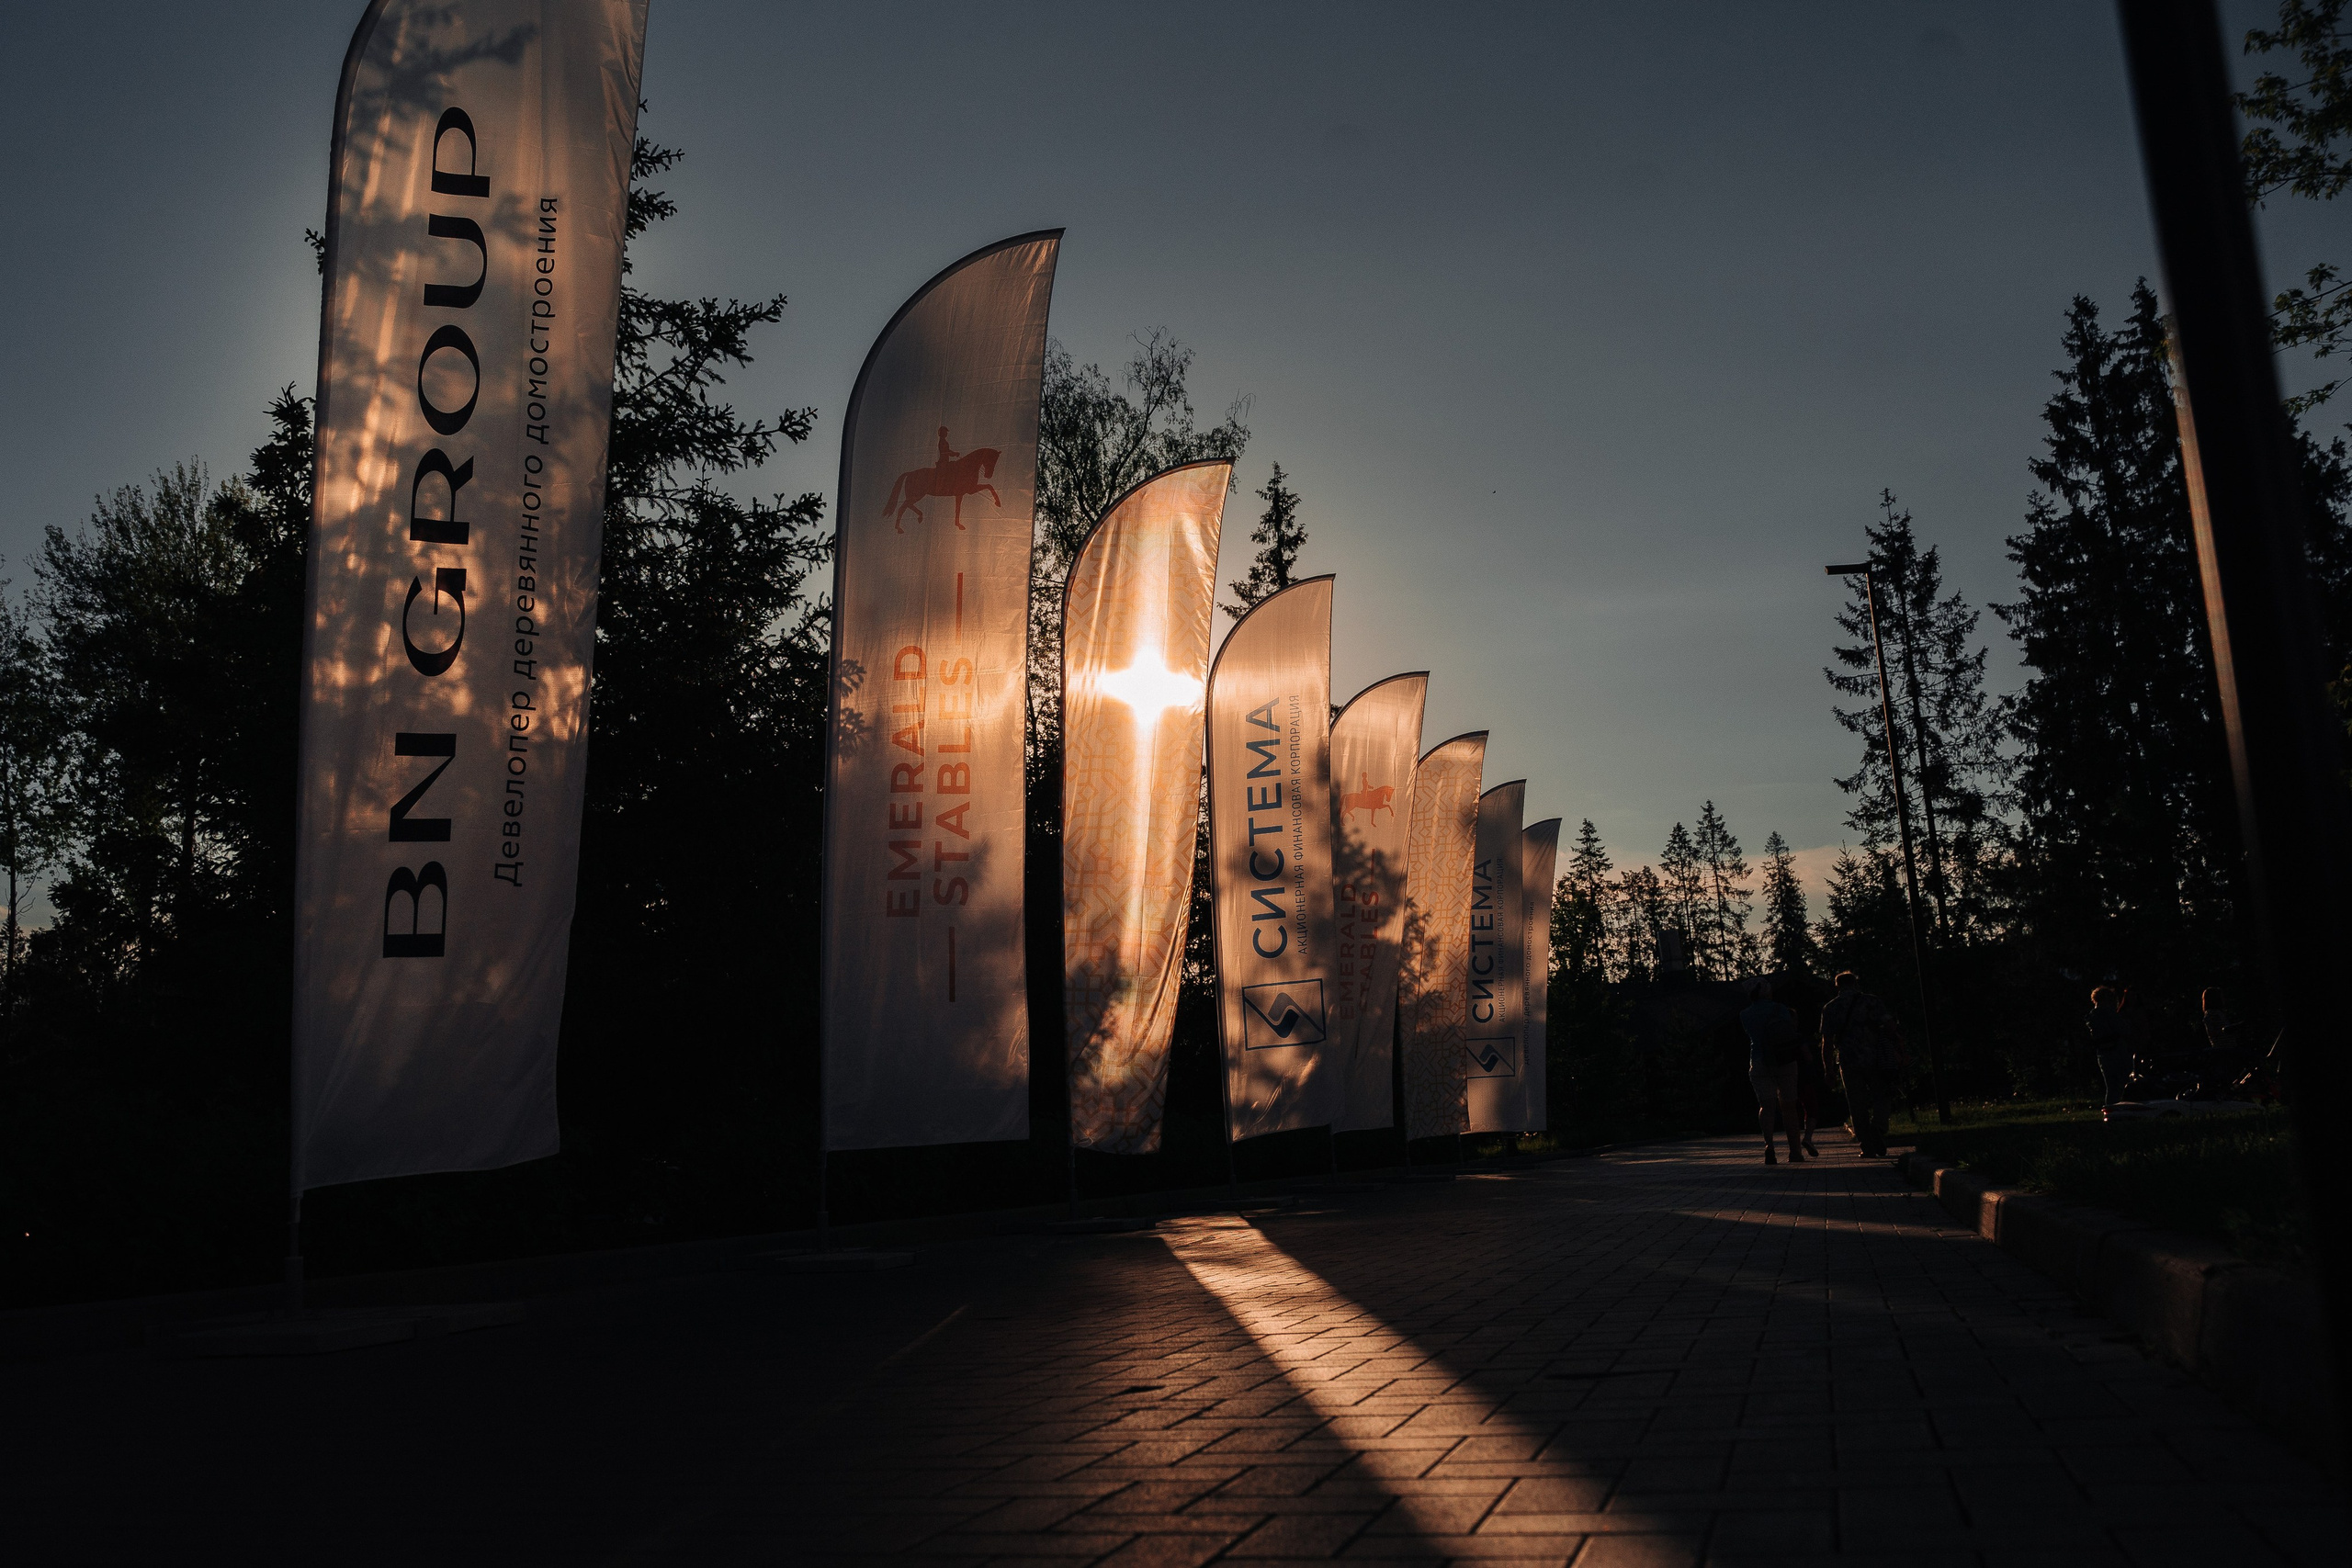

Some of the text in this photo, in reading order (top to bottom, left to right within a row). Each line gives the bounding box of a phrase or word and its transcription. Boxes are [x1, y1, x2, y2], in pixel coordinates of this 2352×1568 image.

[382, 107, 492, 959] BN GROUP
[494, 197, 560, 887] Девелопер деревянного домостроения
[887, 645, 927, 919] EMERALD
[933, 656, 973, 907] STABLES
[1245, 696, 1288, 959] СИСТЕМА
[1288, 694, 1308, 954] АКЦИОНЕРНАЯ ФИНАНСОВАЯ КОРПОРАЦИЯ
[1340, 883, 1356, 1020] EMERALD
[1471, 858, 1495, 1024] СИСТЕМА
[1496, 858, 1506, 1023] АКЦИОНЕРНАЯ ФИНАНСОВАЯ КОРПОРАЦИЯ
[1525, 901, 1535, 961] домостроения
